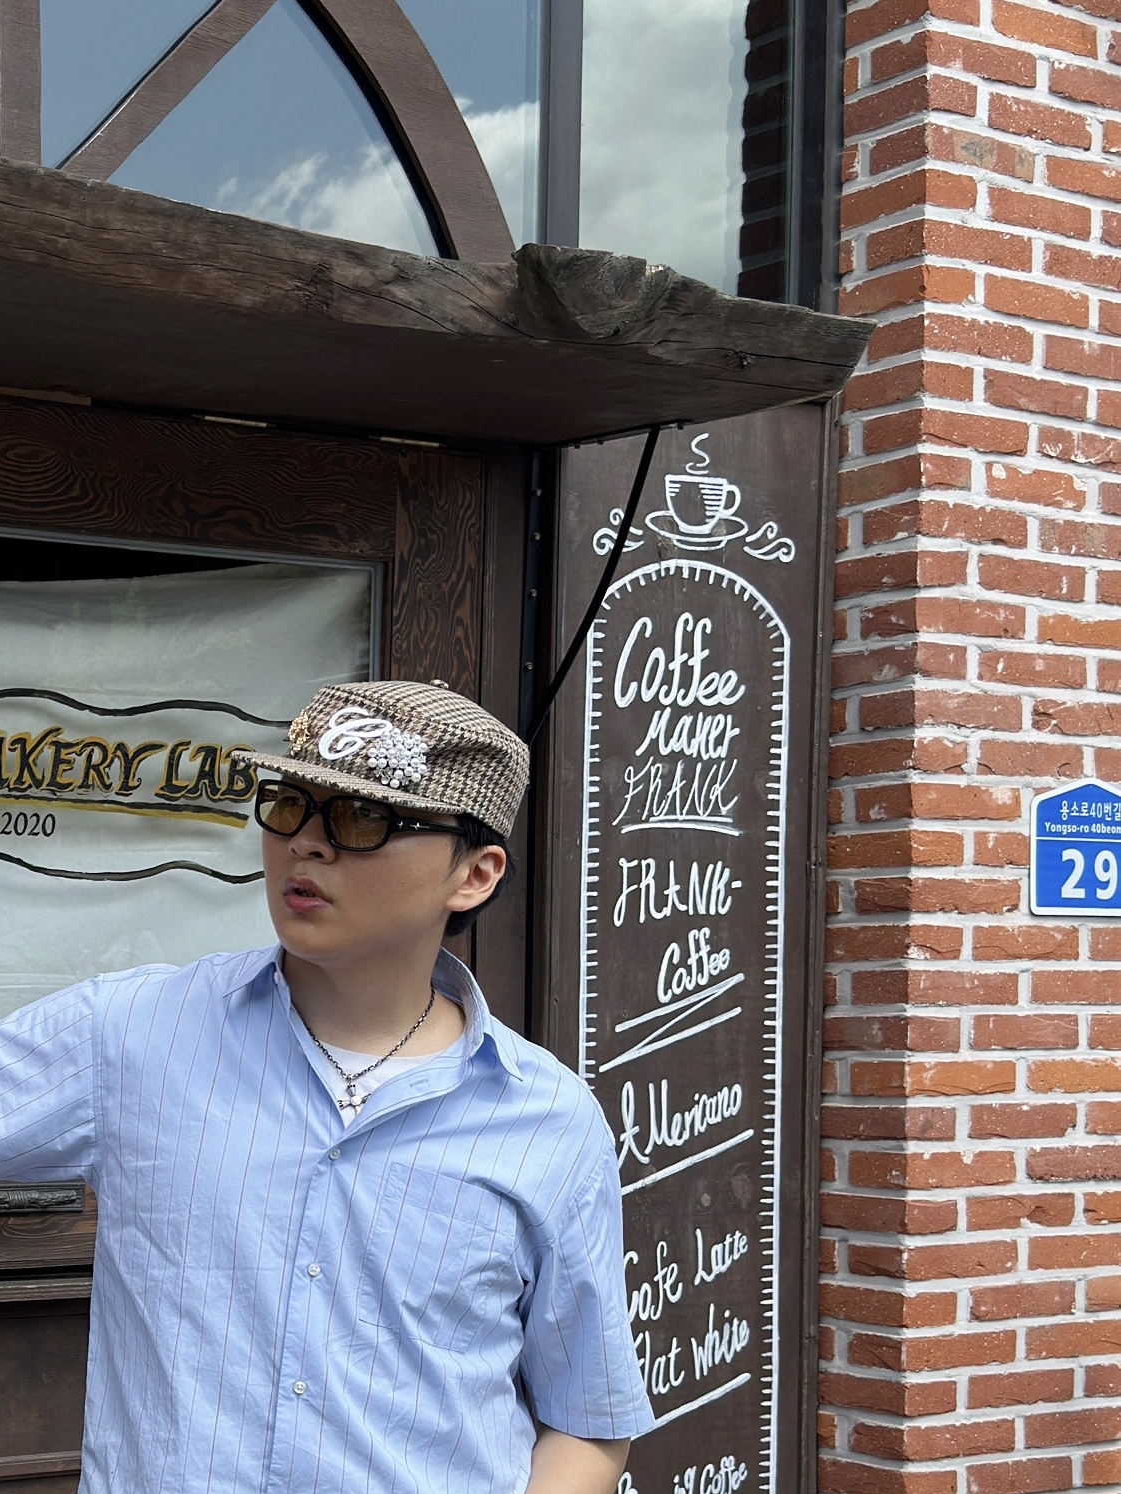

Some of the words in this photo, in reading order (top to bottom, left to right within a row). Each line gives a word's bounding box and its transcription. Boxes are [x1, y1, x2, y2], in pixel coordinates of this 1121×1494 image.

[615, 612, 746, 708] Coffee
[635, 707, 740, 760] Maker
[155, 738, 259, 803] LAB
[612, 756, 739, 826] FRANK
[0, 811, 57, 838] 2020
[1044, 821, 1090, 836] Yongso-ro
[1061, 848, 1118, 901] 29
[657, 927, 730, 1004] Coffee
[694, 1228, 749, 1286] Latte
